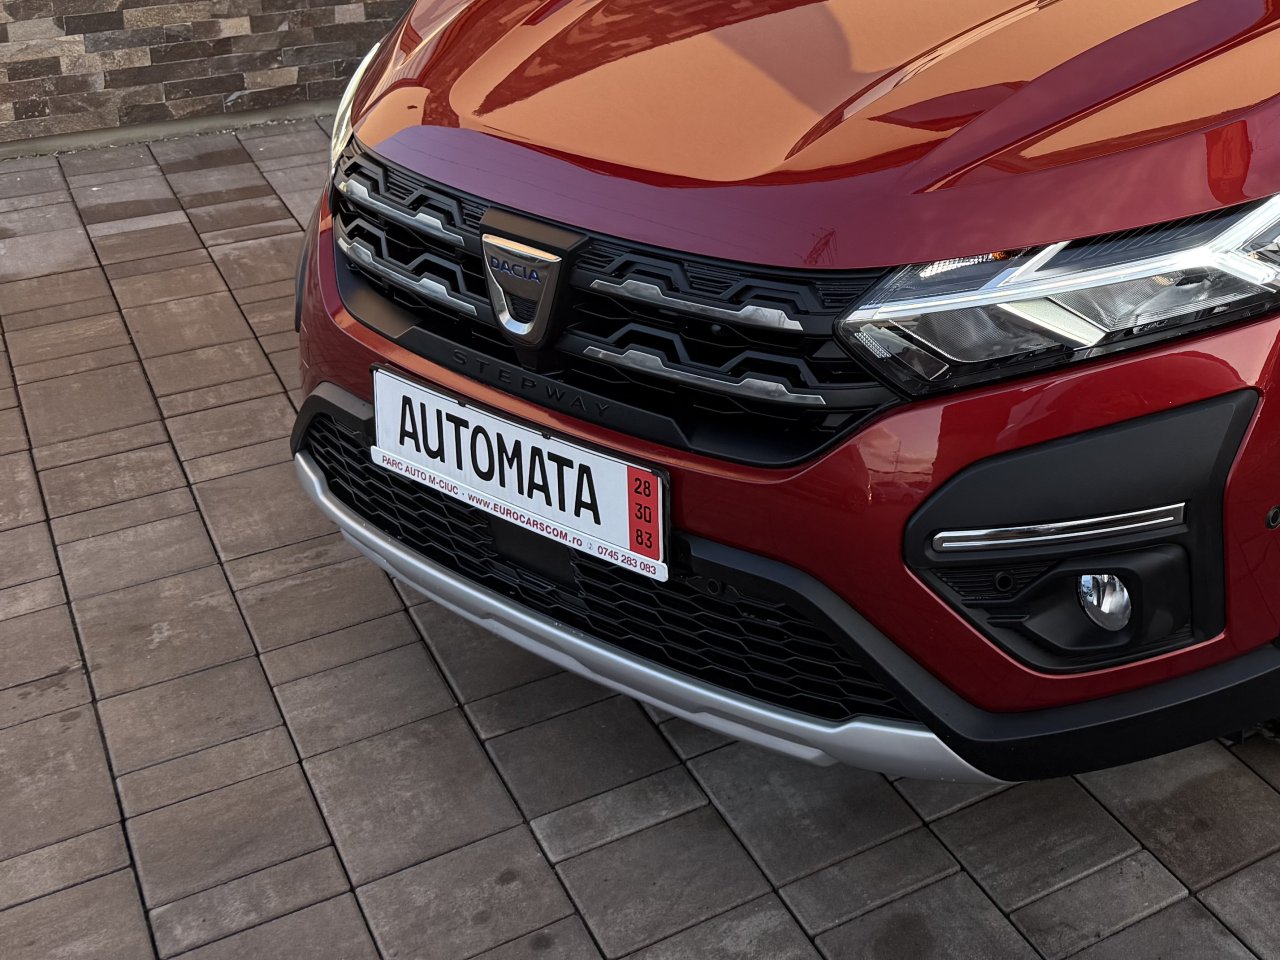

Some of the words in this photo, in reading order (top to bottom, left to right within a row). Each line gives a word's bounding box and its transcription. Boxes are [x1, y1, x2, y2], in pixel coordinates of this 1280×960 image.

[490, 255, 542, 284] DACIA
[452, 348, 610, 416] STEPWAY
[399, 394, 602, 526] AUTOMATA
[634, 477, 651, 498] 28
[382, 455, 403, 471] PARC
[405, 465, 427, 481] AUTO
[428, 474, 459, 496] M-CIUC
[467, 492, 583, 547] www.EUROCARSCOM.ro
[597, 545, 619, 561] 0745
[620, 554, 638, 568] 283
[639, 561, 657, 575] 083
[635, 502, 652, 524] 30
[635, 528, 653, 549] 83
